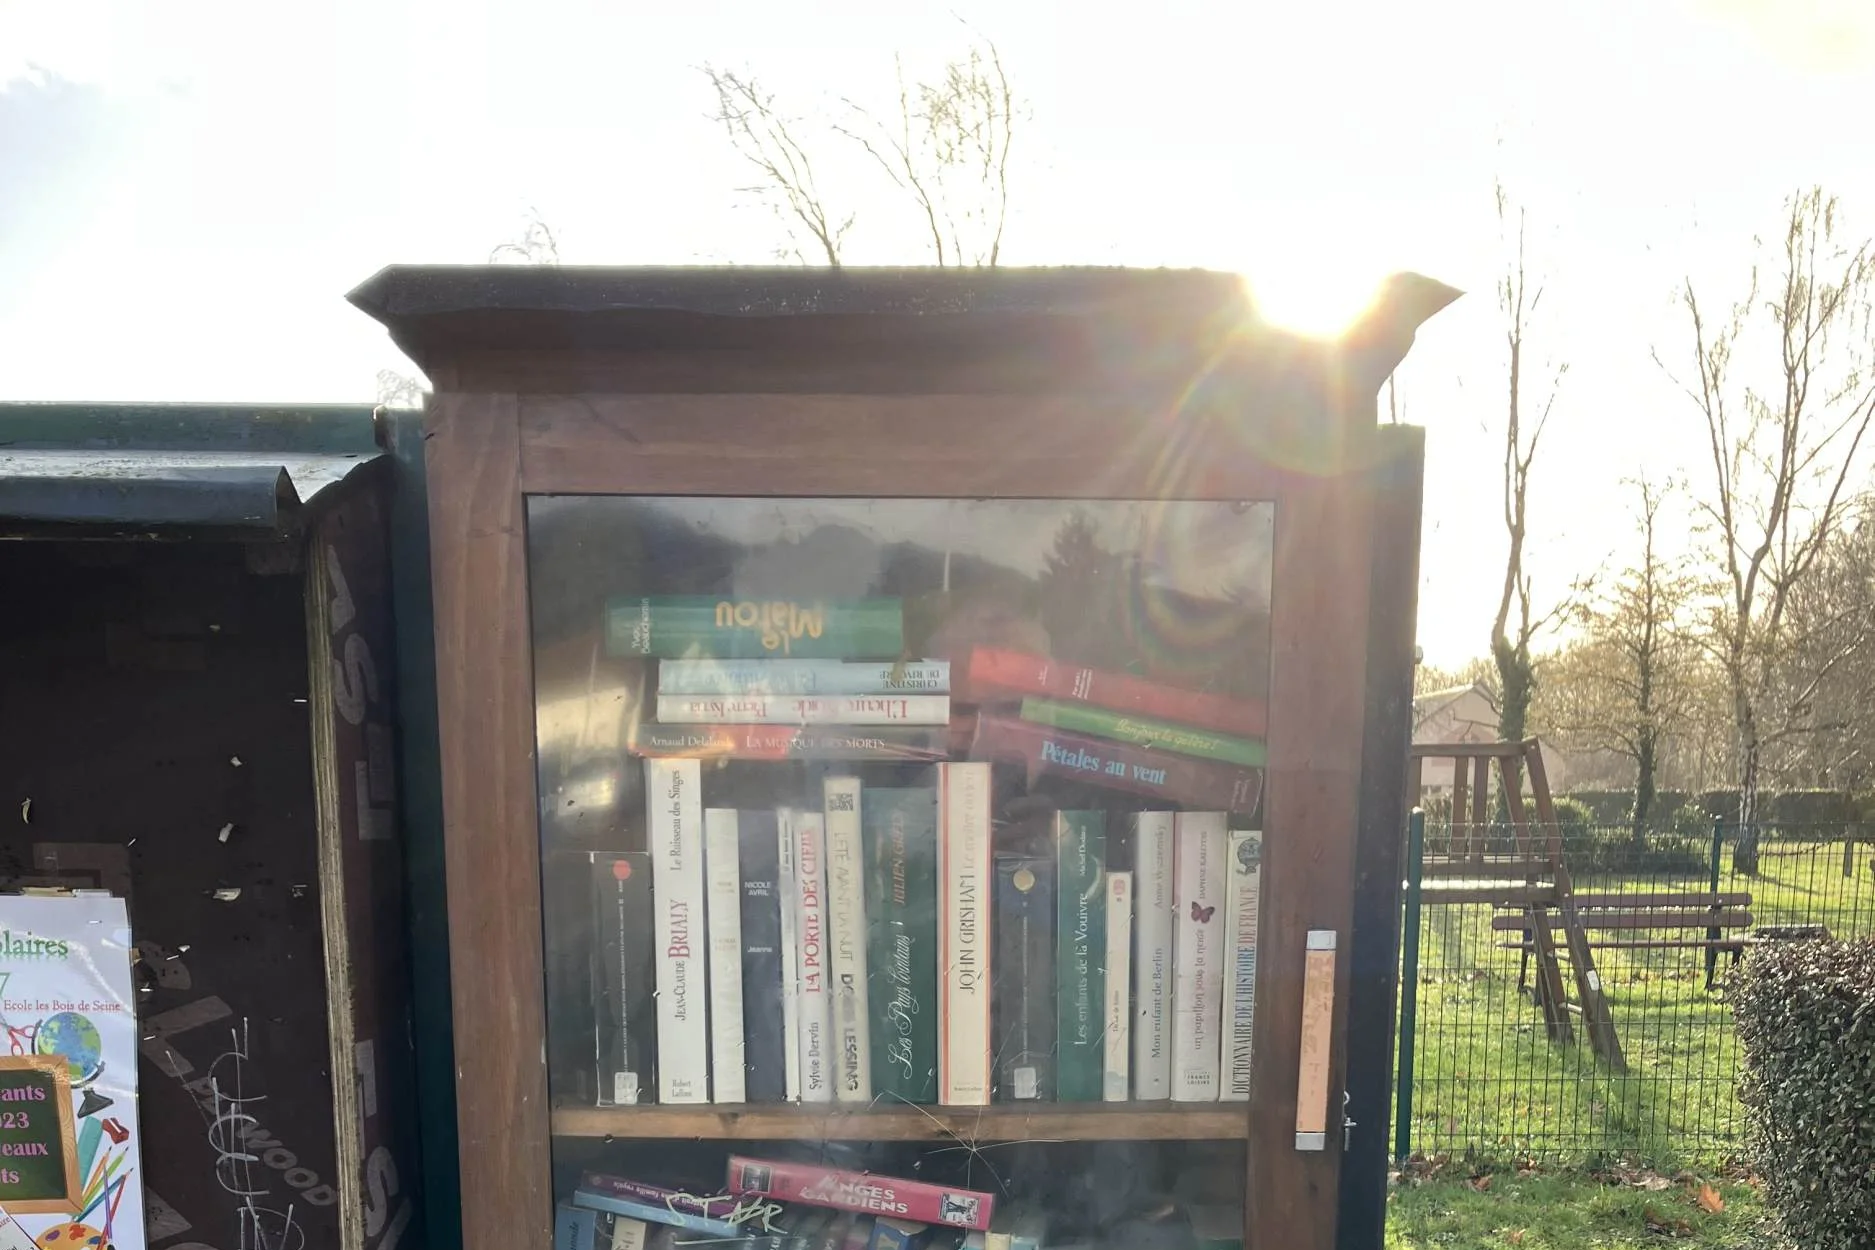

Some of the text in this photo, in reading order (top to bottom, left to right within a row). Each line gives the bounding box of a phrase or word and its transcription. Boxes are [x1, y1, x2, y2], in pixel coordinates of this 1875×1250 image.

[715, 601, 824, 638] Matou
[650, 735, 685, 747] Arnaud
[846, 736, 886, 750] MORTS
[1042, 740, 1167, 785] Pétales au vent
[671, 769, 684, 799] Singes
[1153, 824, 1167, 880] Wzemsky
[744, 882, 772, 890] NICOLE
[748, 889, 770, 897] AVRIL
[1073, 892, 1088, 942] Vouivre
[804, 913, 820, 969] PORTE
[958, 874, 976, 995] JOHN GRISHAM
[668, 899, 692, 1021] JEAN-CLAUDE BRIALY
[1075, 959, 1088, 975] de
[805, 974, 821, 993] LA
[1232, 886, 1258, 1095] DICTIONNAIRE DE L'HISTOIRE DE FRANCE
[36, 1000, 49, 1011] les
[52, 1000, 74, 1011] Bois
[78, 1000, 90, 1011] de
[92, 1000, 121, 1012] Seine
[1075, 977, 1088, 1022] enfants
[1151, 948, 1162, 1059] Mon enfant de Berlin
[1074, 1024, 1088, 1045] Les
[808, 1056, 821, 1091] Sylvie
[843, 1026, 859, 1092] LESSING
[0, 1084, 46, 1102] ants
[0, 1111, 30, 1129] 23
[0, 1142, 49, 1157] eaux
[0, 1167, 20, 1184] ts
[799, 1185, 909, 1214] GADIENS
